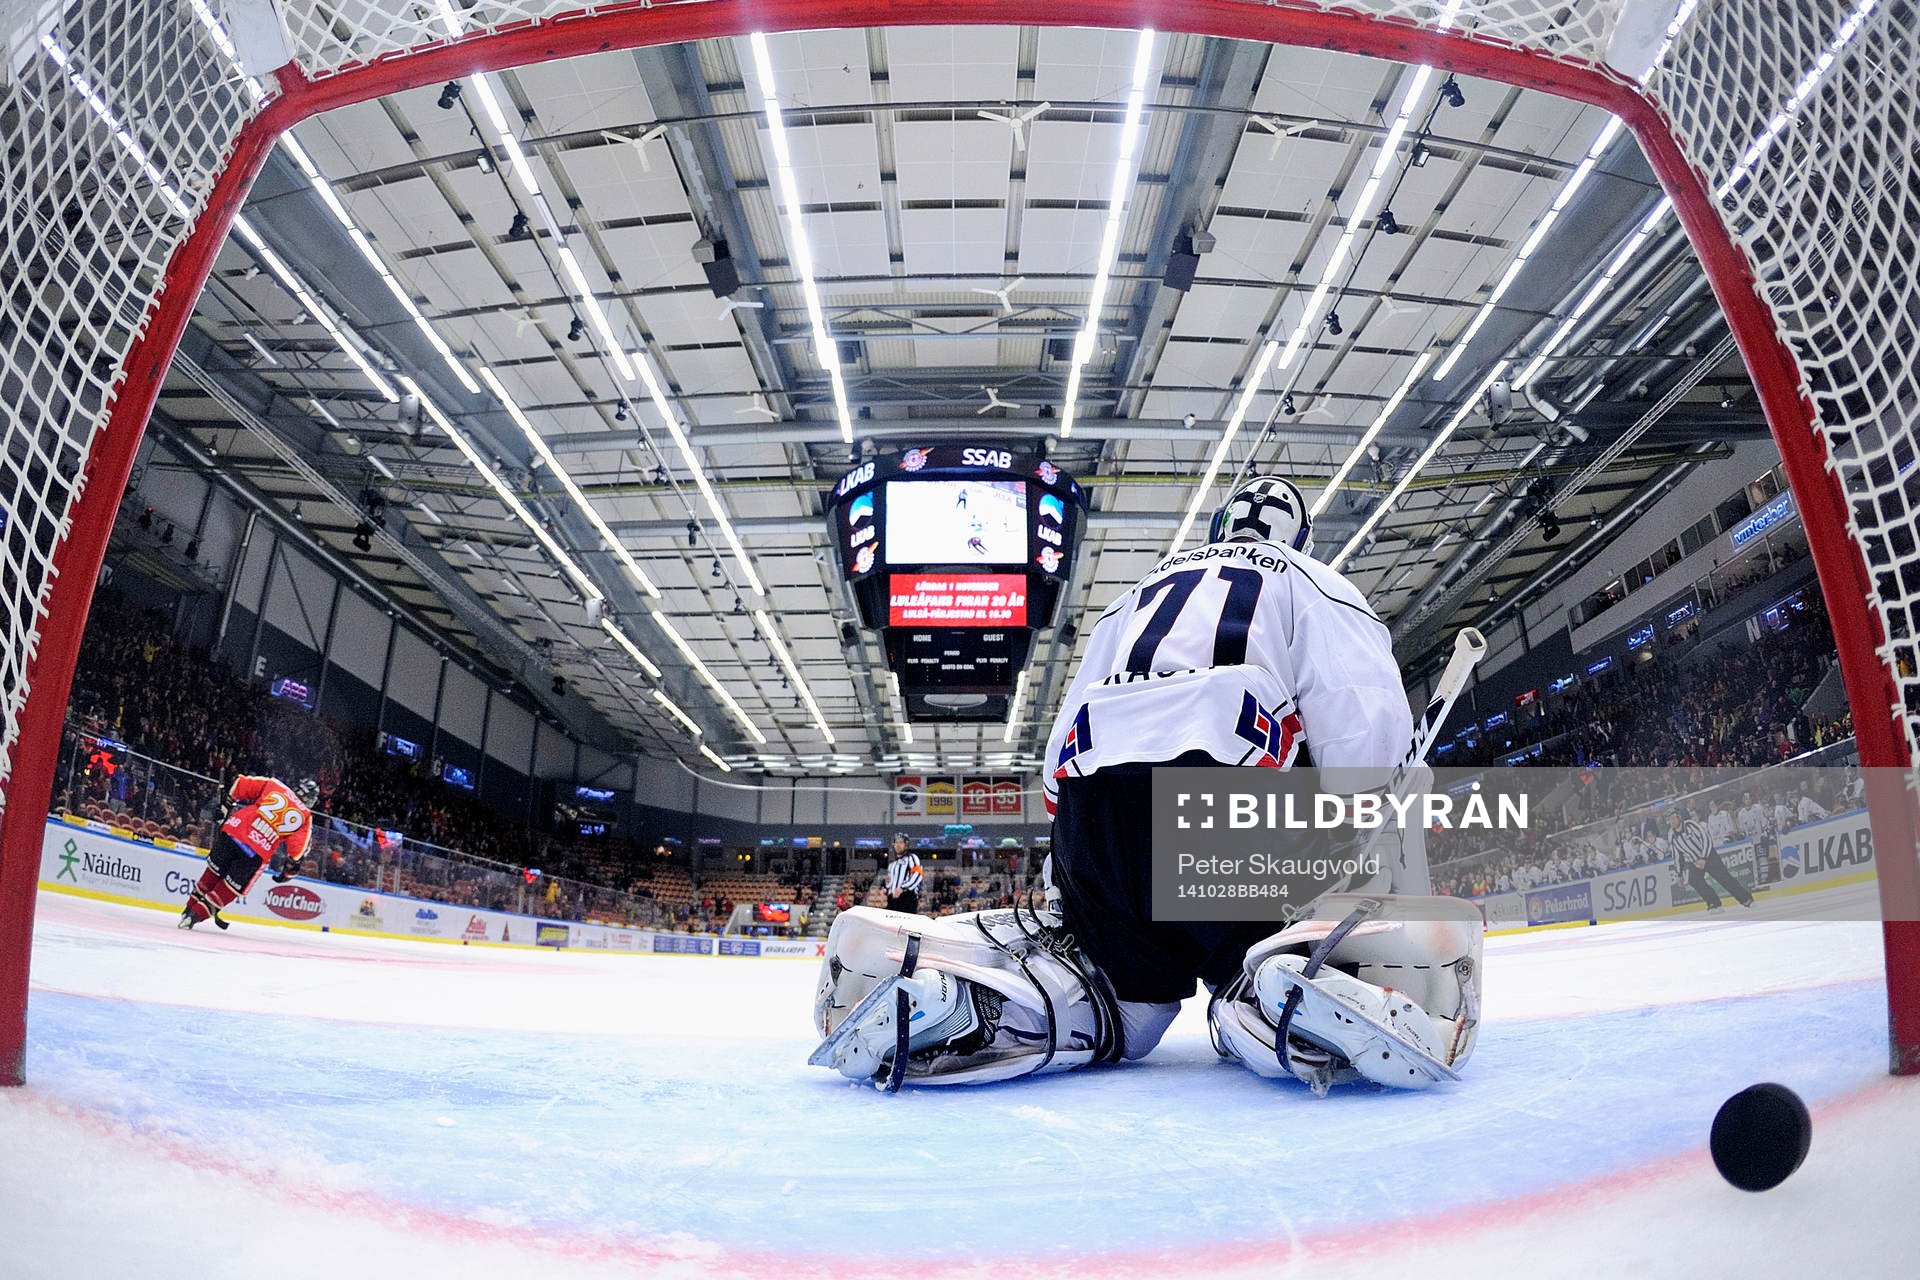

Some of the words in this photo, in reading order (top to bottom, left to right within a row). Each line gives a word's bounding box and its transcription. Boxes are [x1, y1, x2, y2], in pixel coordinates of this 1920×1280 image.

[962, 448, 1012, 469] SSAB
[840, 462, 875, 497] LKAB
[850, 525, 875, 548] LKAB
[1037, 525, 1062, 546] LKAB
[1150, 546, 1288, 574] delsbanken
[1125, 565, 1264, 672] 71
[913, 634, 932, 642] HOME
[983, 633, 1004, 642] GUEST
[254, 655, 267, 678] E
[968, 788, 986, 805] 12
[257, 791, 305, 834] 29
[1803, 828, 1873, 875] LKAB
[1544, 893, 1589, 914] Polarbröd
[1603, 875, 1657, 912] SSAB
